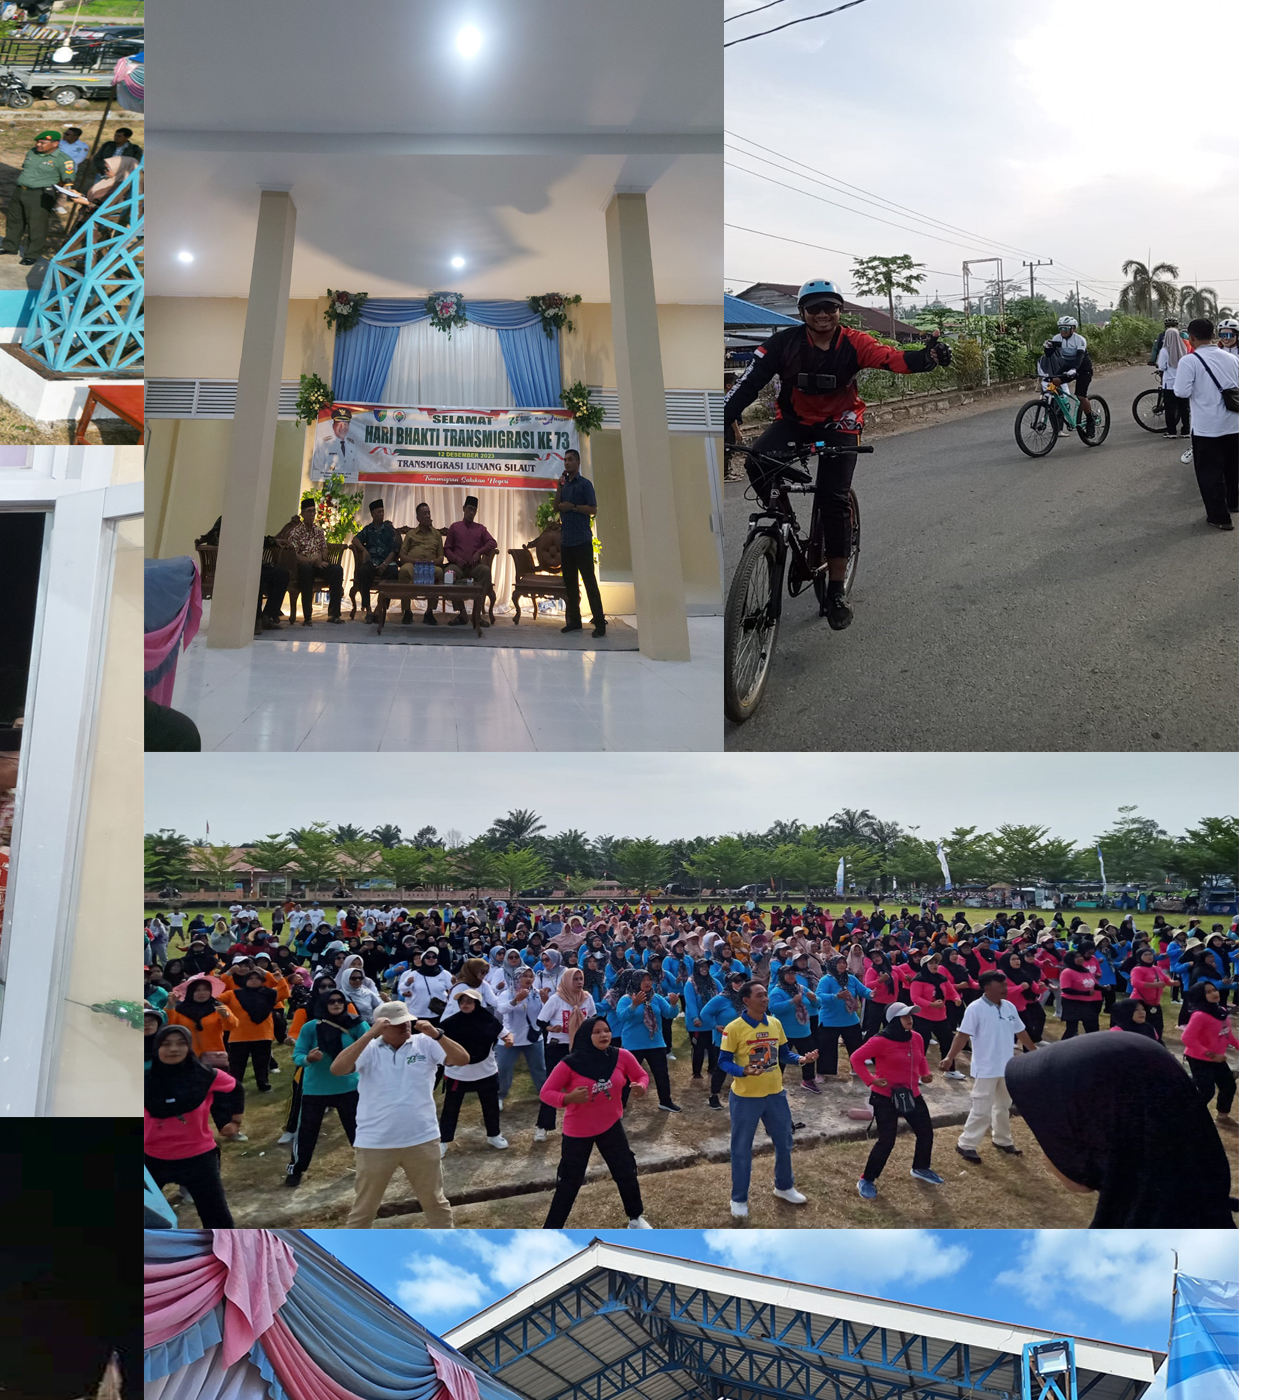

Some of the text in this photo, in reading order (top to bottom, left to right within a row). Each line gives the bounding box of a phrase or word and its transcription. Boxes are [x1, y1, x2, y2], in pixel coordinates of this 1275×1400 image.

[432, 414, 494, 426] SELAMAT
[365, 425, 571, 450] HARI BHAKTI TRANSMIGRASI KE 73
[397, 460, 537, 473] TRANSMIGRASI LUNANG SILAUT
